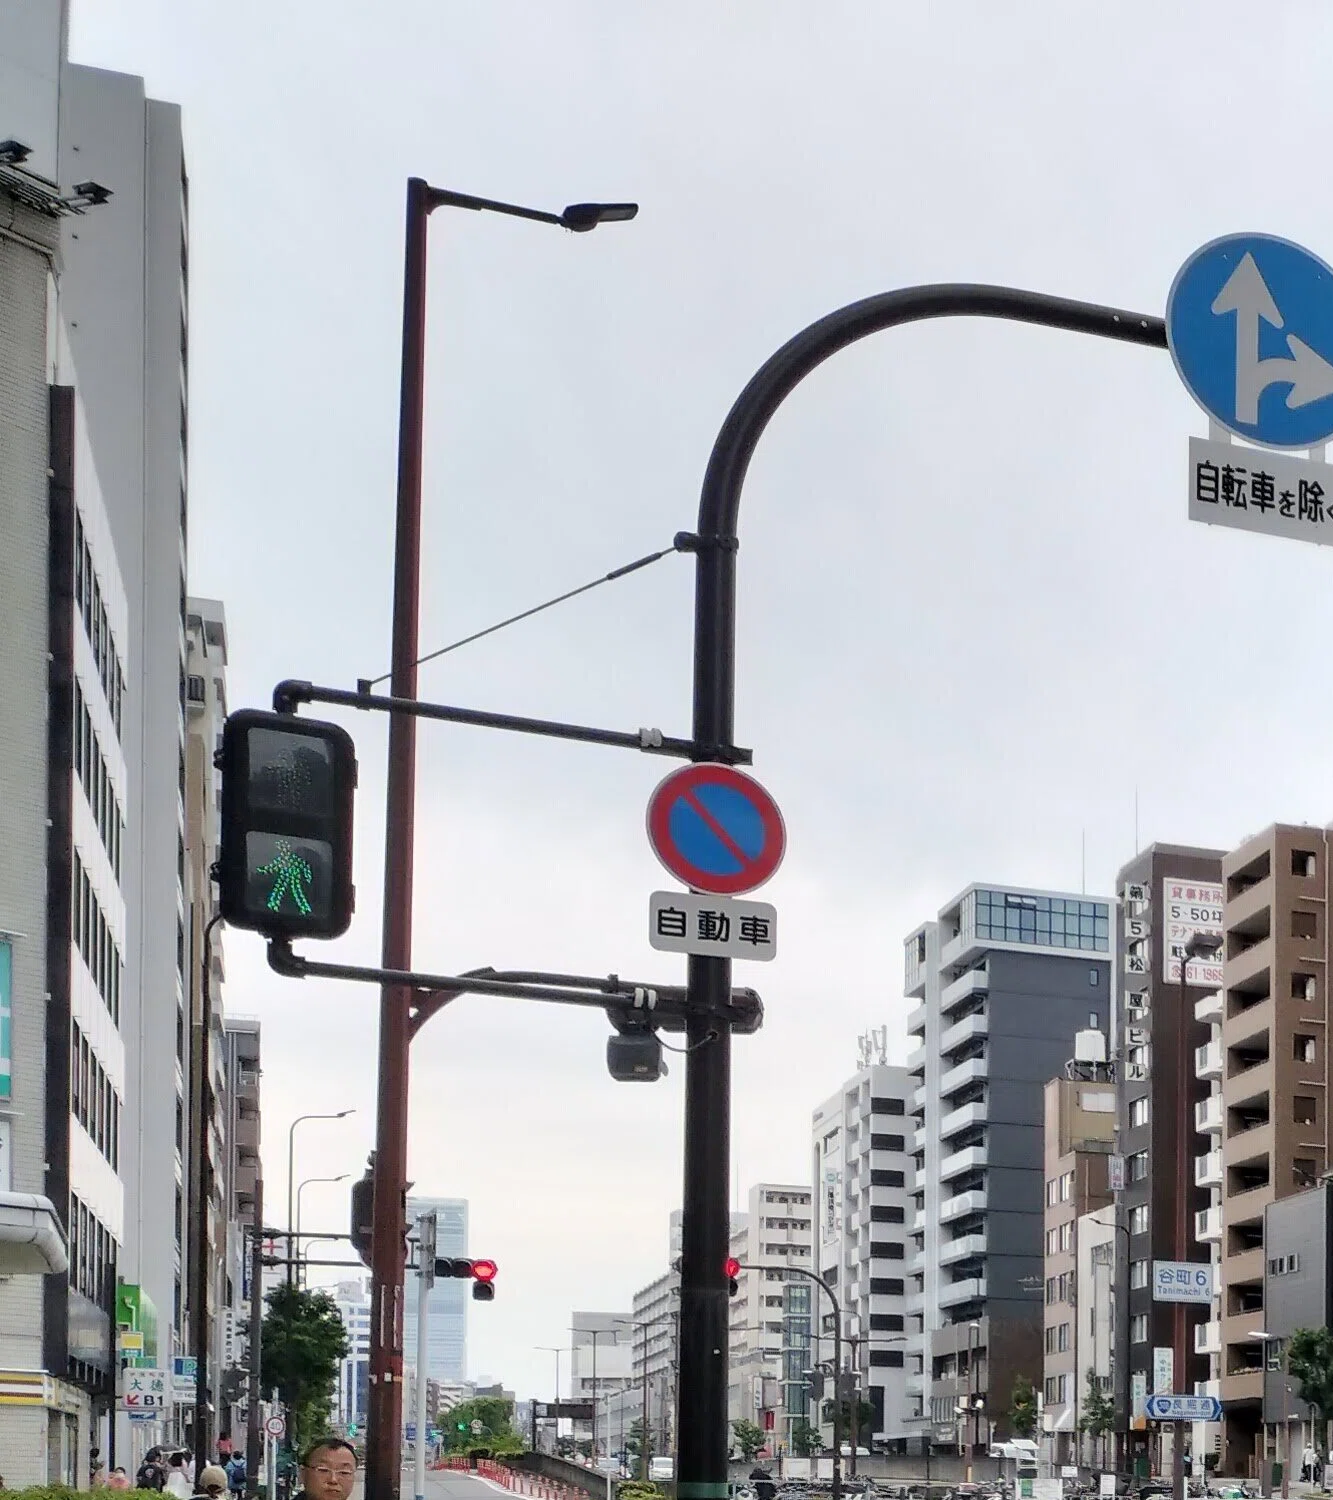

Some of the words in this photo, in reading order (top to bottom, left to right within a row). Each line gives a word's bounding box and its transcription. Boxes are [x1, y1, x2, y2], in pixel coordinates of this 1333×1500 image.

[657, 906, 771, 946] 自動車
[1158, 1285, 1201, 1296] Tanimachi
[1205, 1288, 1210, 1296] 6
[143, 1395, 164, 1406] B1
